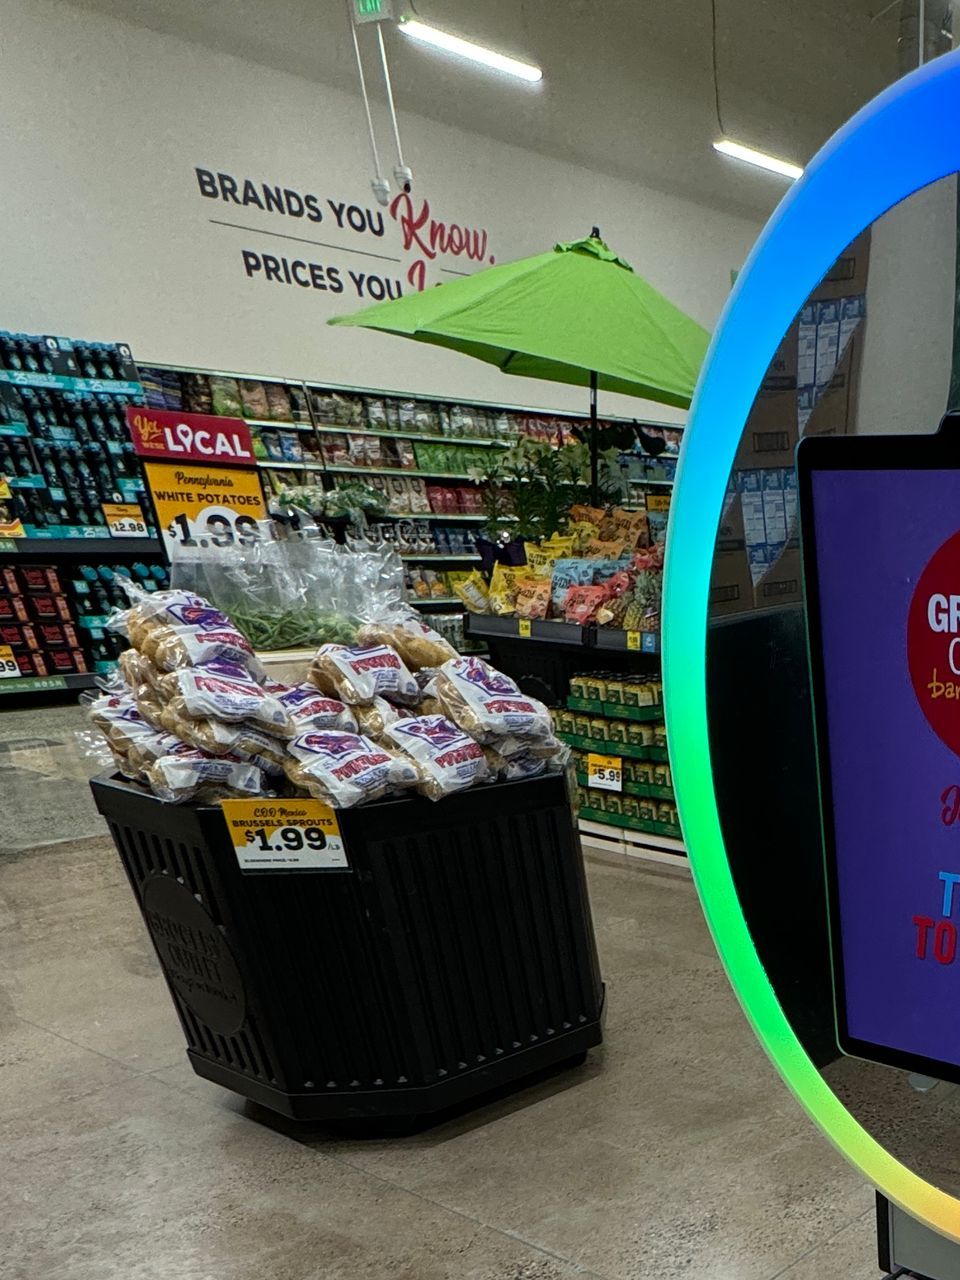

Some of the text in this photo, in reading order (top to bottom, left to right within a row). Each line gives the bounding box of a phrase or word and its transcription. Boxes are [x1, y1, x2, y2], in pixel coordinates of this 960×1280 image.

[195, 167, 496, 265] BRANDS YOU Know.
[241, 250, 344, 294] PRICES
[348, 271, 403, 301] YOU
[163, 423, 251, 458] LOCAL
[174, 471, 234, 489] Pennsylvania
[154, 490, 261, 506] WHITE POTATOES
[232, 818, 334, 828] BRUSSELS SPROUTS
[912, 914, 958, 966] TO
